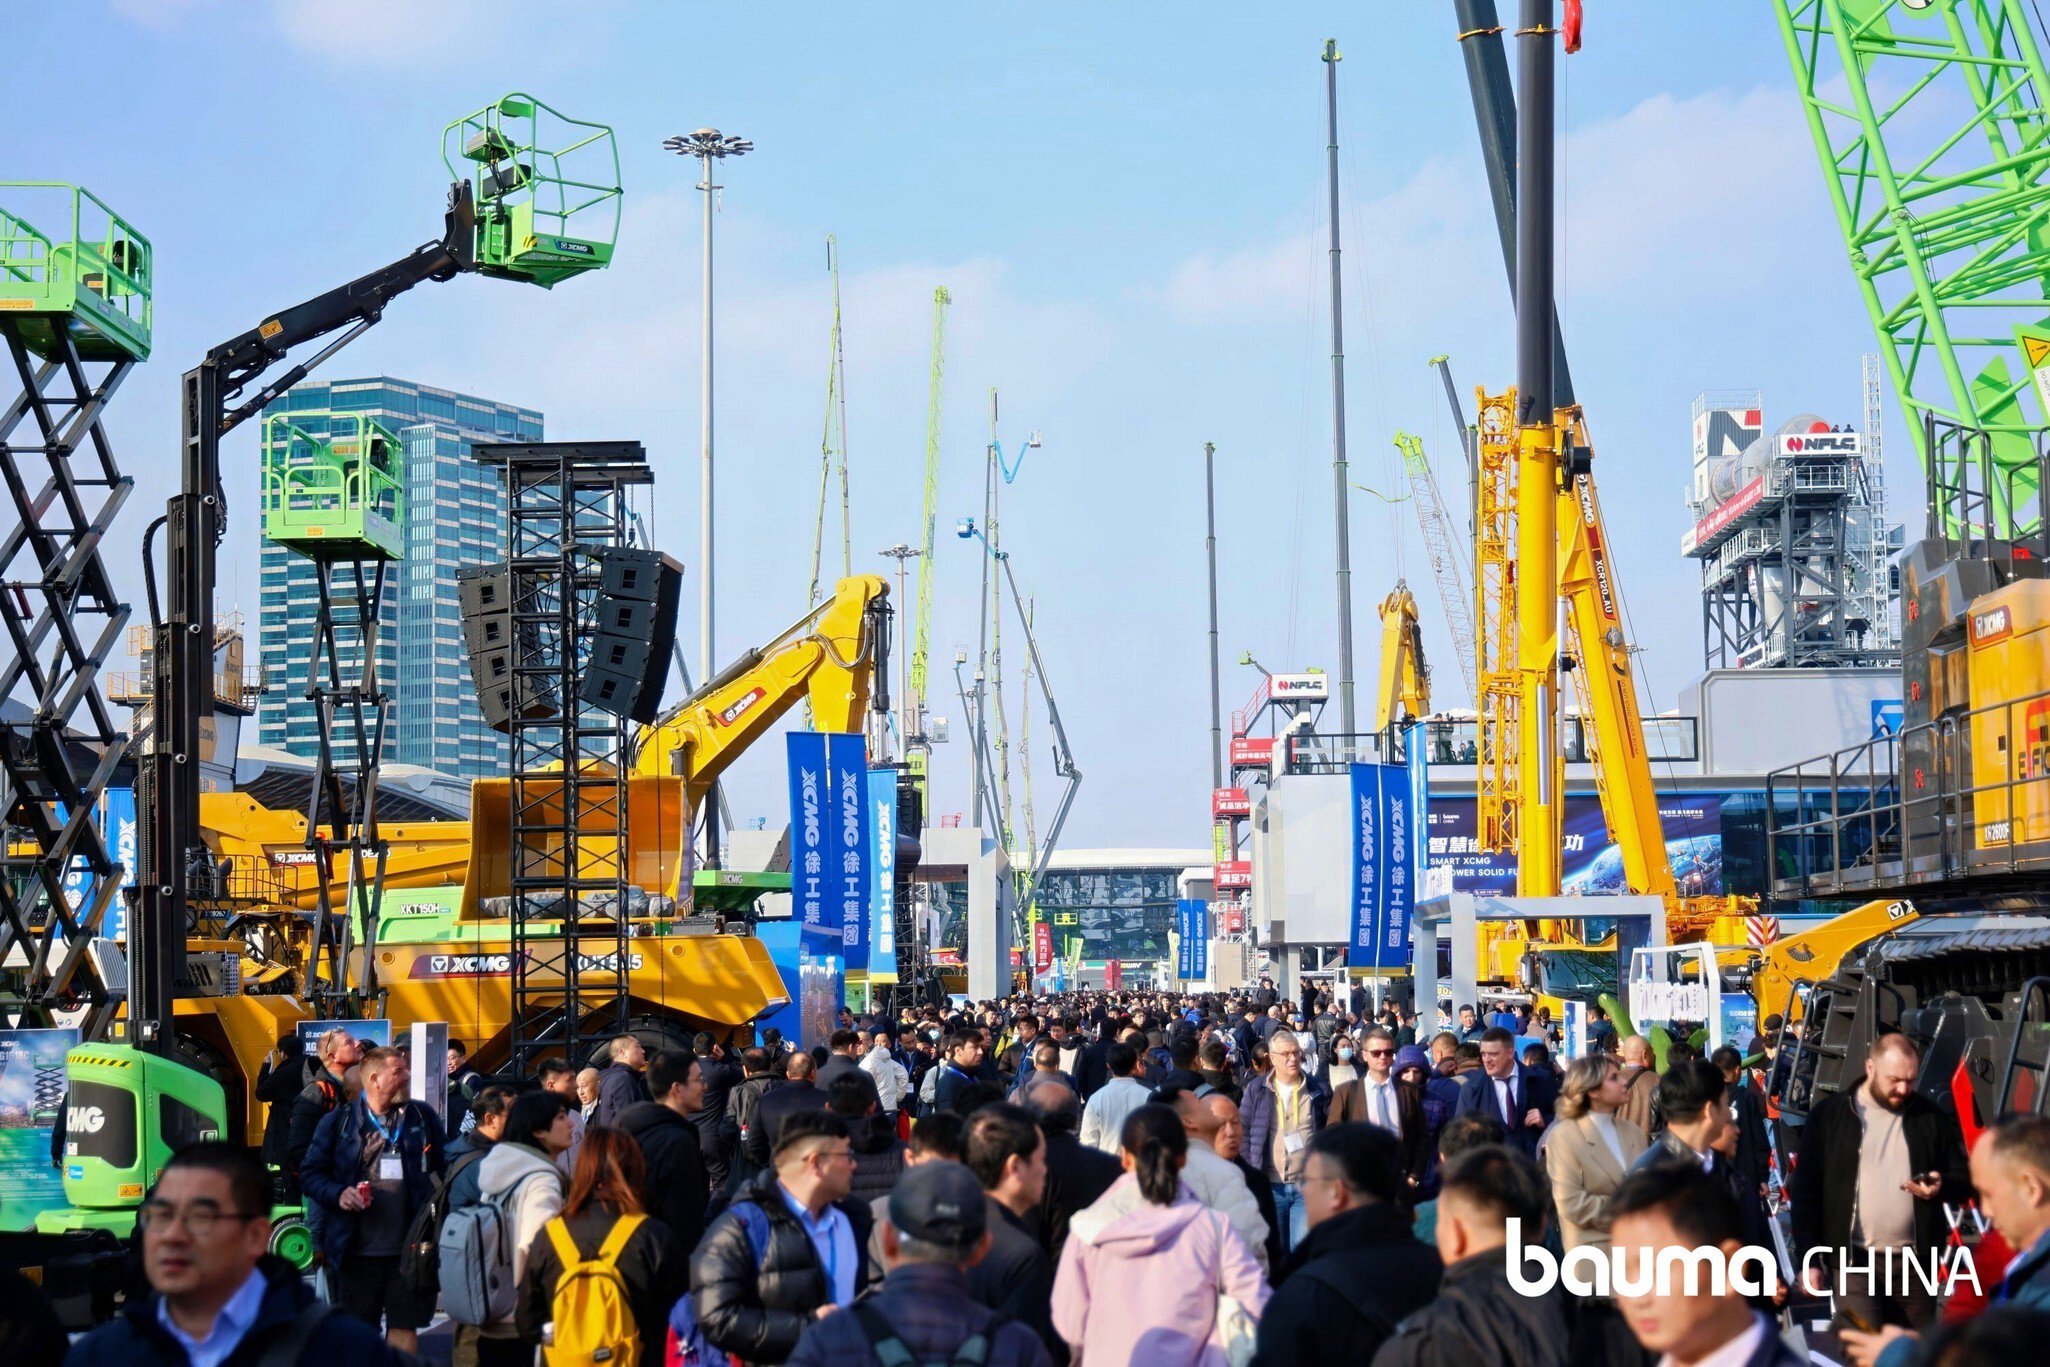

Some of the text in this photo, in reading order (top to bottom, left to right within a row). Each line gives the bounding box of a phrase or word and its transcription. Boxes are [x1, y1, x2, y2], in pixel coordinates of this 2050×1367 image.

[568, 244, 588, 252] XCMG
[1804, 437, 1855, 451] NFLG
[1578, 483, 1595, 524] XCMG
[1983, 611, 2005, 637] XCMG
[1289, 681, 1323, 690] NFLG
[877, 799, 892, 868] XCMG
[119, 817, 136, 886] XCMG
[801, 766, 821, 924] XCMG 徐工集
[842, 768, 861, 946] XCMG 徐工集团
[1430, 857, 1491, 865] SMART XCMG
[723, 874, 743, 884] XCMG
[1358, 792, 1374, 947] XCMG 徐工集团
[1388, 793, 1406, 948] XCMG 徐工集团
[1478, 868, 1505, 876] SOLID
[400, 904, 440, 915] XKT150H
[449, 956, 510, 973] XCMG
